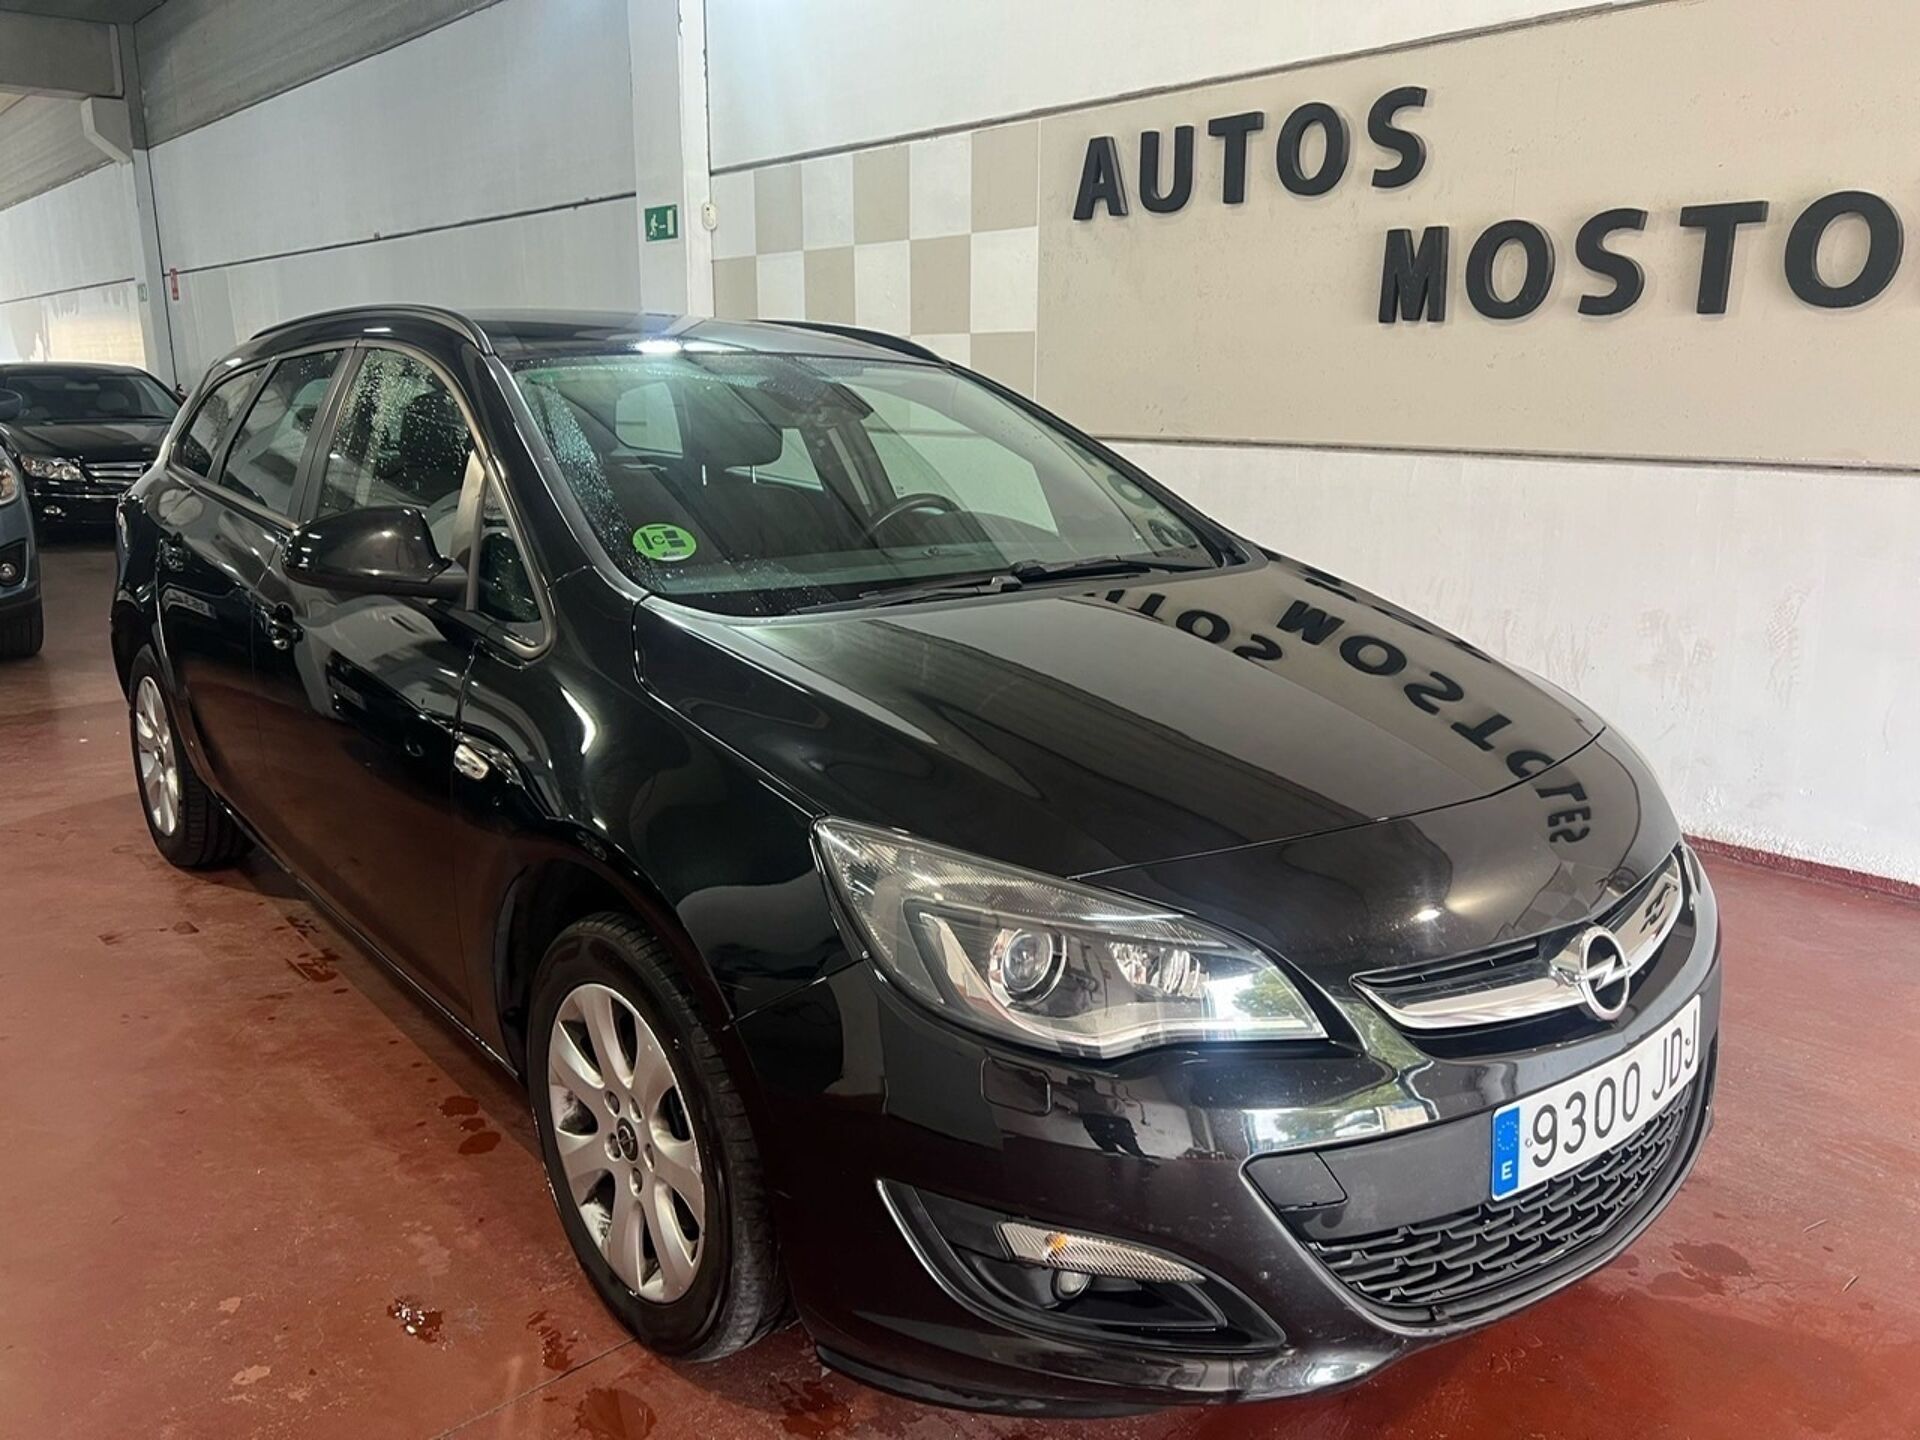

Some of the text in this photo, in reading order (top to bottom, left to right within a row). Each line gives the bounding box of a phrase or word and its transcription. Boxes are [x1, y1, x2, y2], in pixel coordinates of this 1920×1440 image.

[1073, 86, 1428, 220] AUTOS
[1378, 190, 1904, 324] MOSTO
[1532, 1009, 1697, 1168] 9300 JDJ
[1502, 1161, 1513, 1180] E
